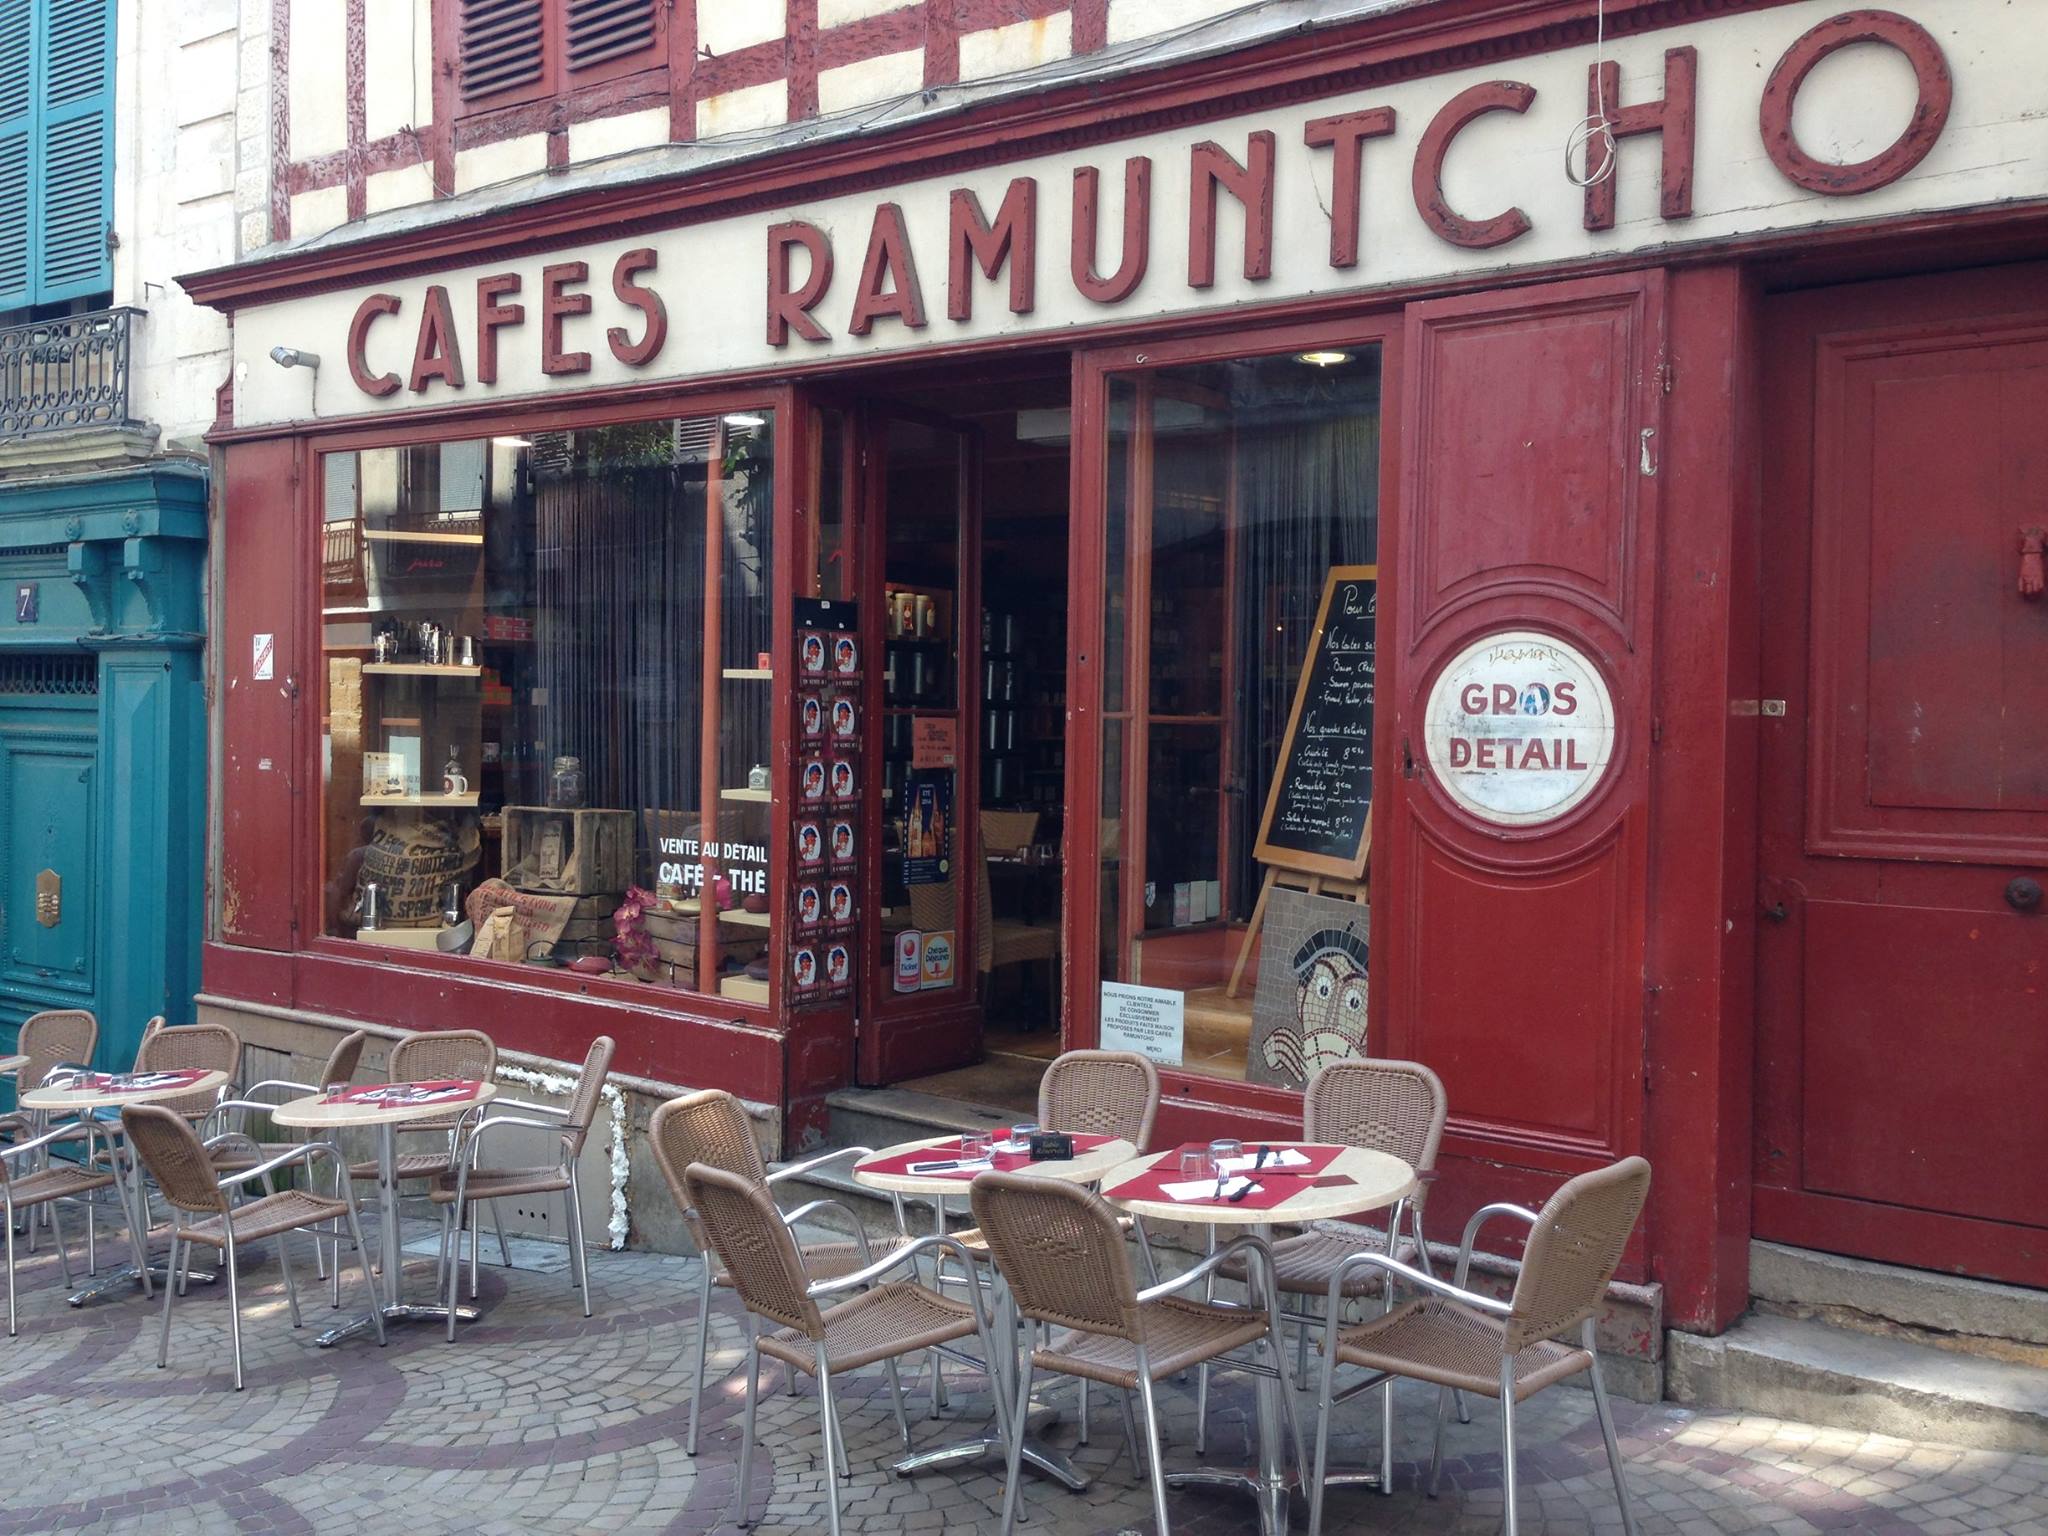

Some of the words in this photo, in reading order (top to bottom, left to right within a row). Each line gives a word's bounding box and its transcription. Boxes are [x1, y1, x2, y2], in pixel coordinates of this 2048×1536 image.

[347, 248, 667, 396] CAFES
[766, 9, 1953, 347] RAMUNTCHO
[20, 588, 31, 617] 7
[1460, 682, 1578, 716] GROS
[1450, 738, 1588, 771] DETAIL
[660, 838, 699, 856] VENTE
[702, 842, 719, 858] AU
[724, 843, 768, 863] DÉTAIL
[660, 861, 704, 887] CAFÉ
[728, 868, 766, 894] THÉ
